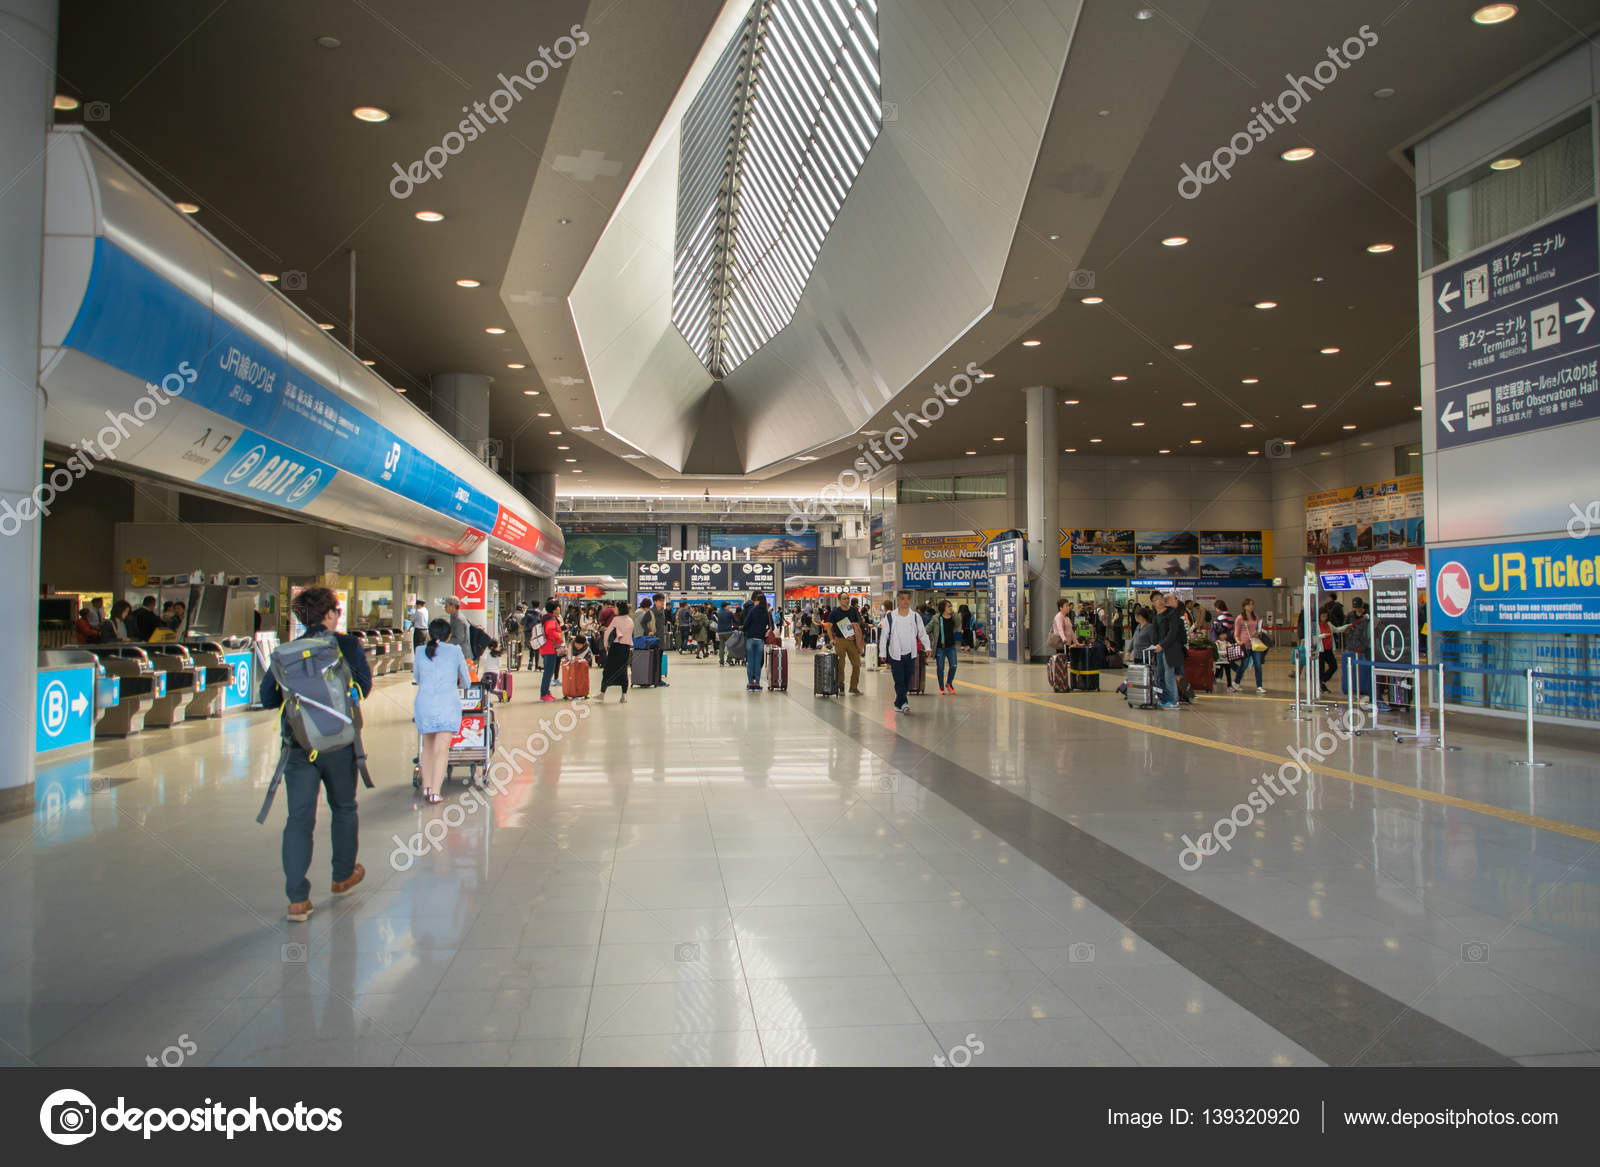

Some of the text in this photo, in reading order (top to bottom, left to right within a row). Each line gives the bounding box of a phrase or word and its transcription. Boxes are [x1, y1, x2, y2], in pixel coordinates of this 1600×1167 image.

[1493, 232, 1566, 275] 第1ターミナル
[1466, 275, 1487, 299] T1
[1493, 261, 1538, 288] Terminal 1
[1459, 316, 1527, 350] 第2ターミナル
[1534, 314, 1558, 340] T2
[1482, 331, 1527, 354] Terminal 2
[1496, 378, 1599, 415] Bus for Observation Hall
[384, 441, 401, 473] JR
[248, 455, 305, 496] GATE
[662, 546, 737, 561] Terminal
[743, 546, 751, 561] 1
[905, 562, 945, 571] NANKAI
[923, 549, 956, 559] OSAKA
[905, 571, 936, 580] TICKET
[1479, 552, 1527, 591] JR
